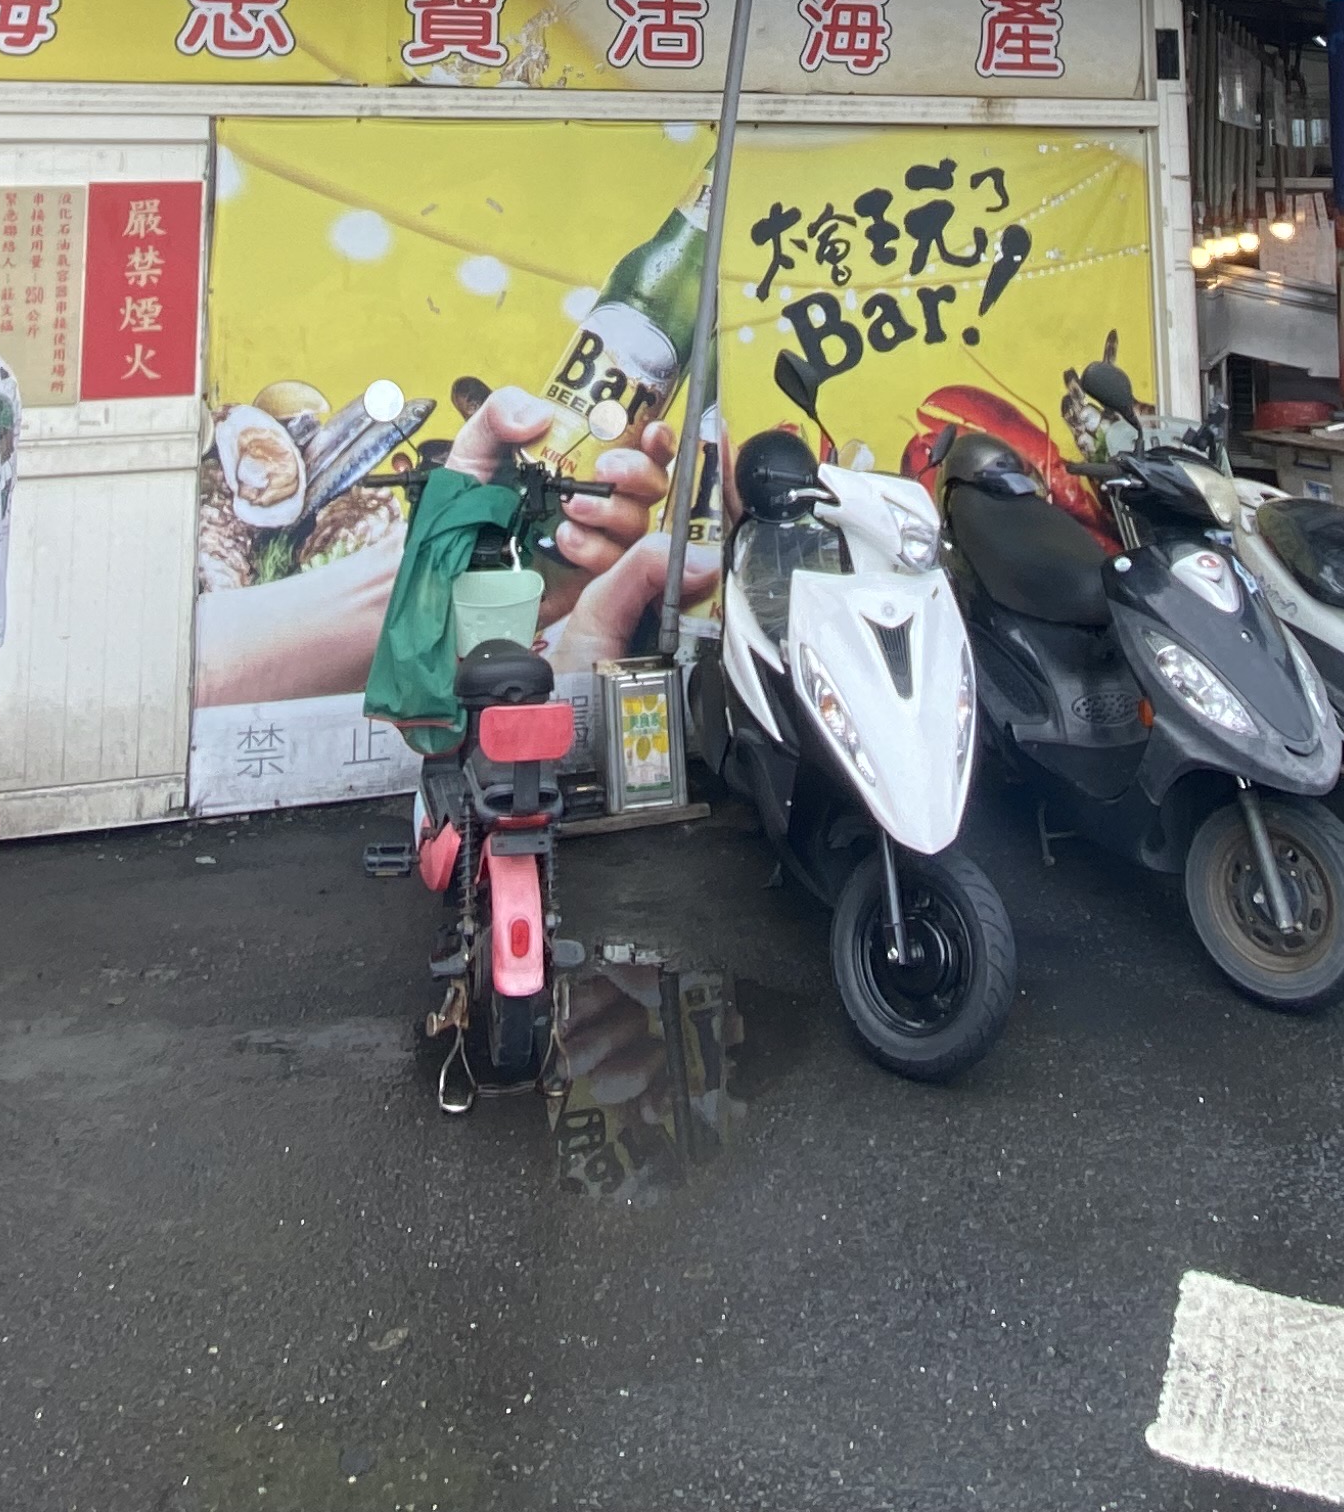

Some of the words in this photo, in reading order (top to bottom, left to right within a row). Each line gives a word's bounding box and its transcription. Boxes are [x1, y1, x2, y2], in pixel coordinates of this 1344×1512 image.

[119, 199, 167, 380] 嚴禁煙火
[546, 384, 596, 418] BEE
[555, 329, 657, 426] Bar
[236, 714, 392, 779] 禁止
